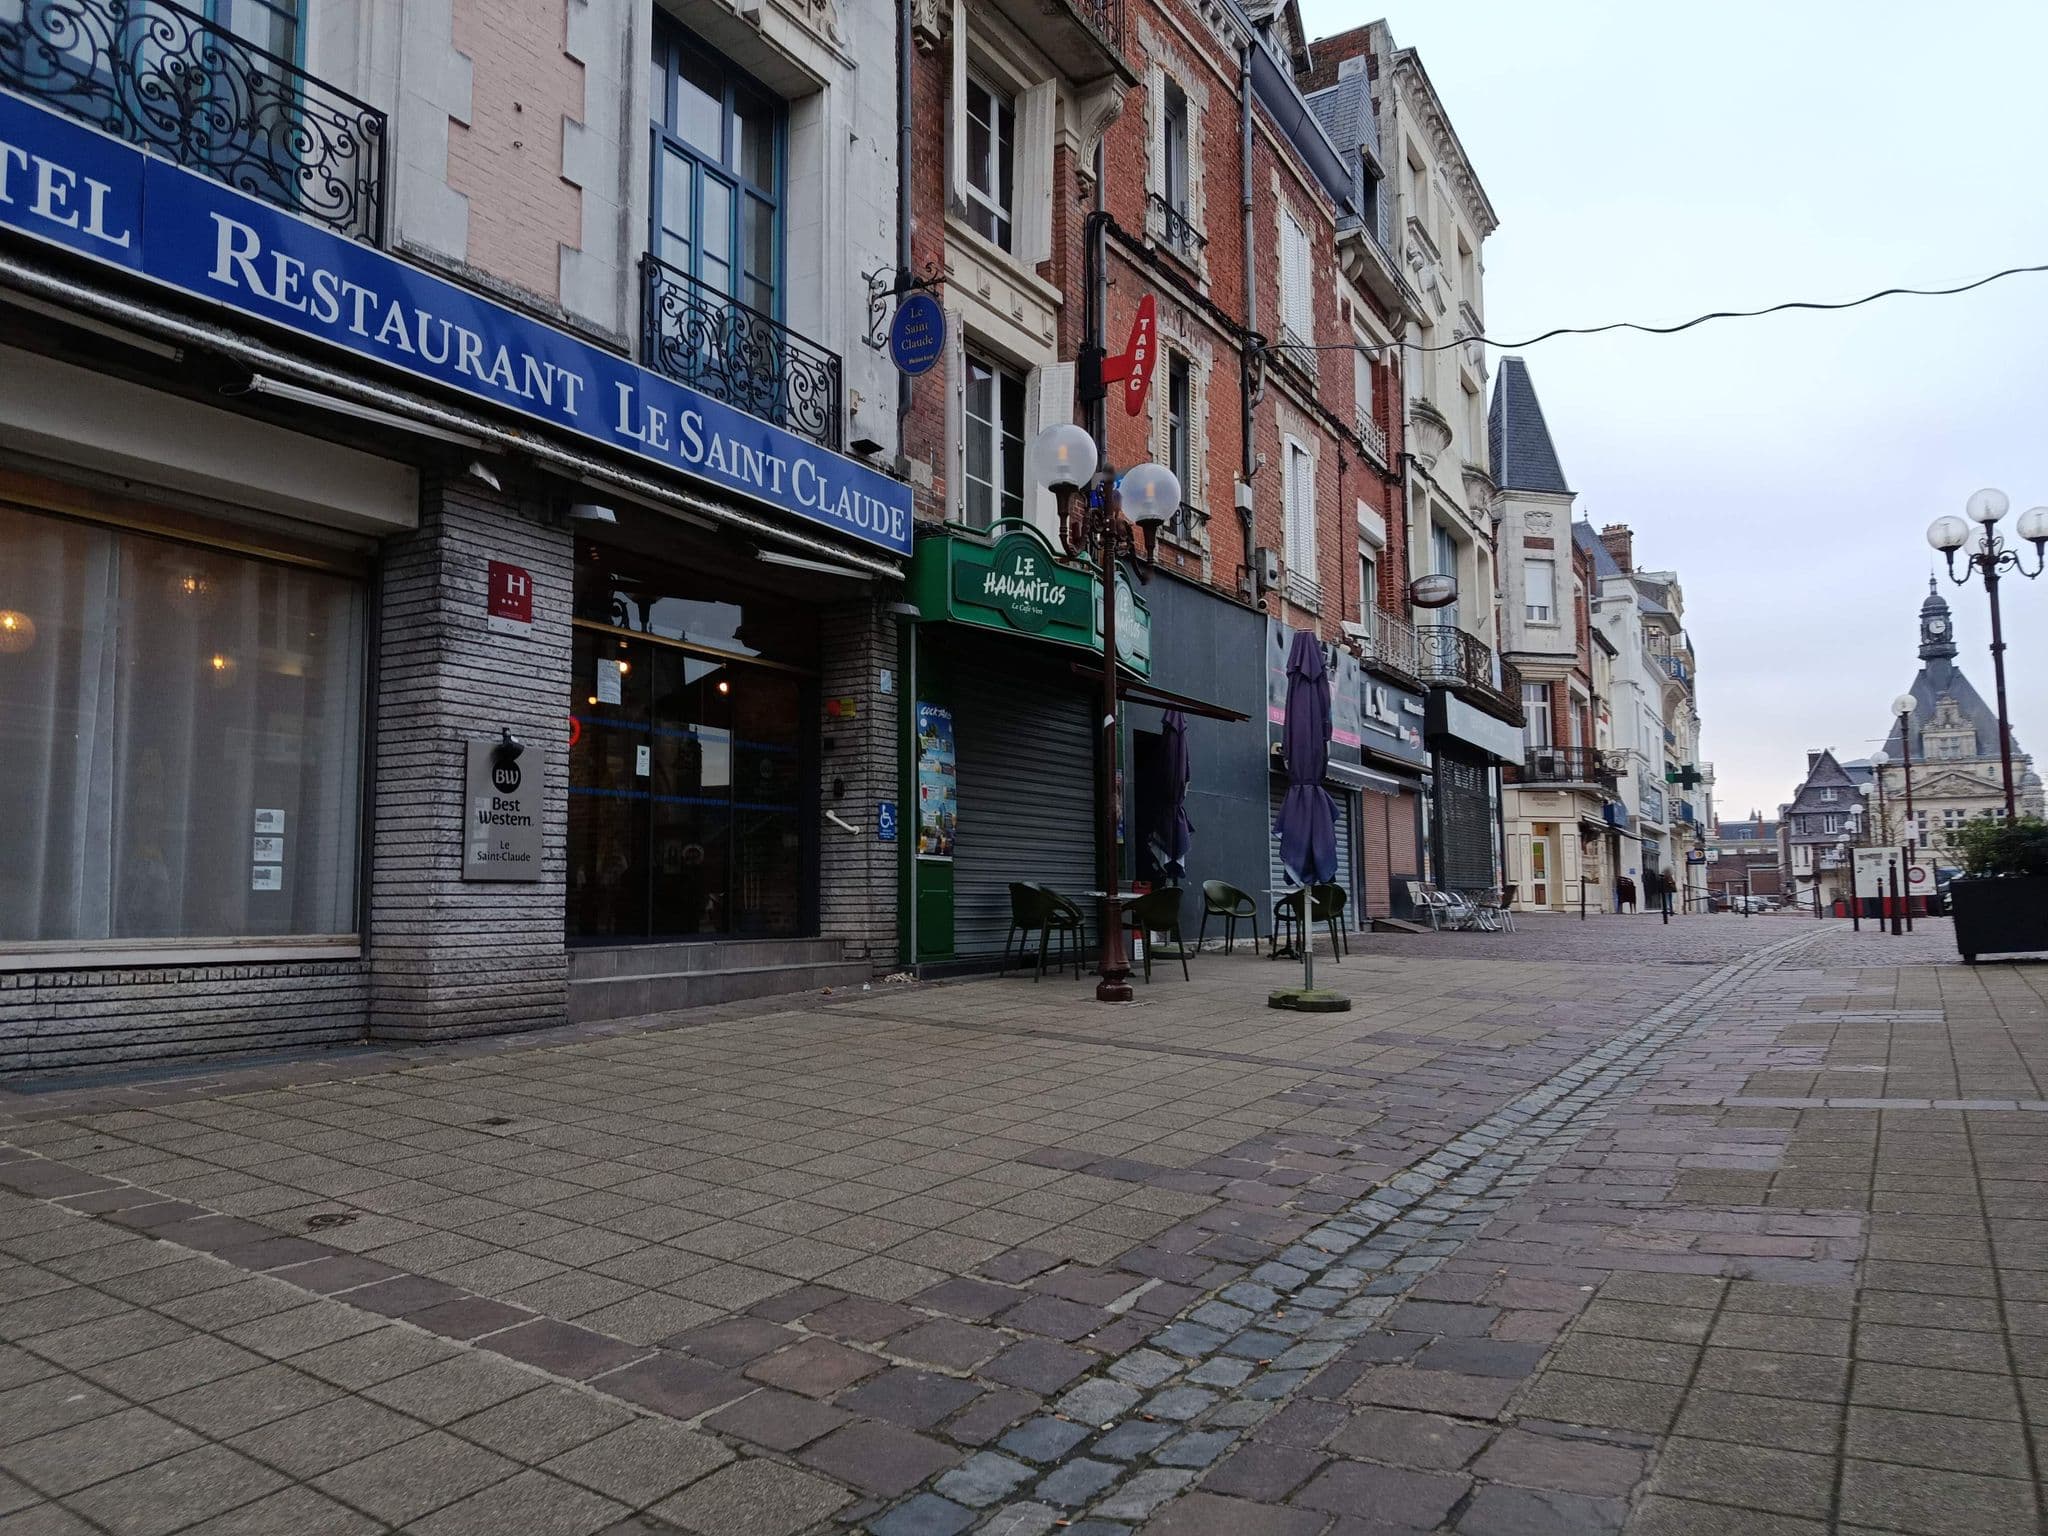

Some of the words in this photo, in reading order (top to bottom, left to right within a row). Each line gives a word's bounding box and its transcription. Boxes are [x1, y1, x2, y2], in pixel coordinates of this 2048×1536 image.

[910, 307, 923, 318] Le
[904, 322, 929, 335] Saint
[901, 335, 933, 351] Claude
[1129, 318, 1149, 391] TABAC
[208, 211, 583, 416] RESTAURANT
[615, 381, 669, 452] LE
[680, 410, 786, 495] SAINT
[791, 458, 905, 543] CLAUDE
[1015, 556, 1034, 576] LE
[507, 574, 525, 597] H
[495, 768, 519, 785] BW
[492, 797, 520, 811] Best
[478, 810, 532, 826] Western
[500, 840, 510, 850] Le
[477, 851, 531, 862] Saint-Claude
